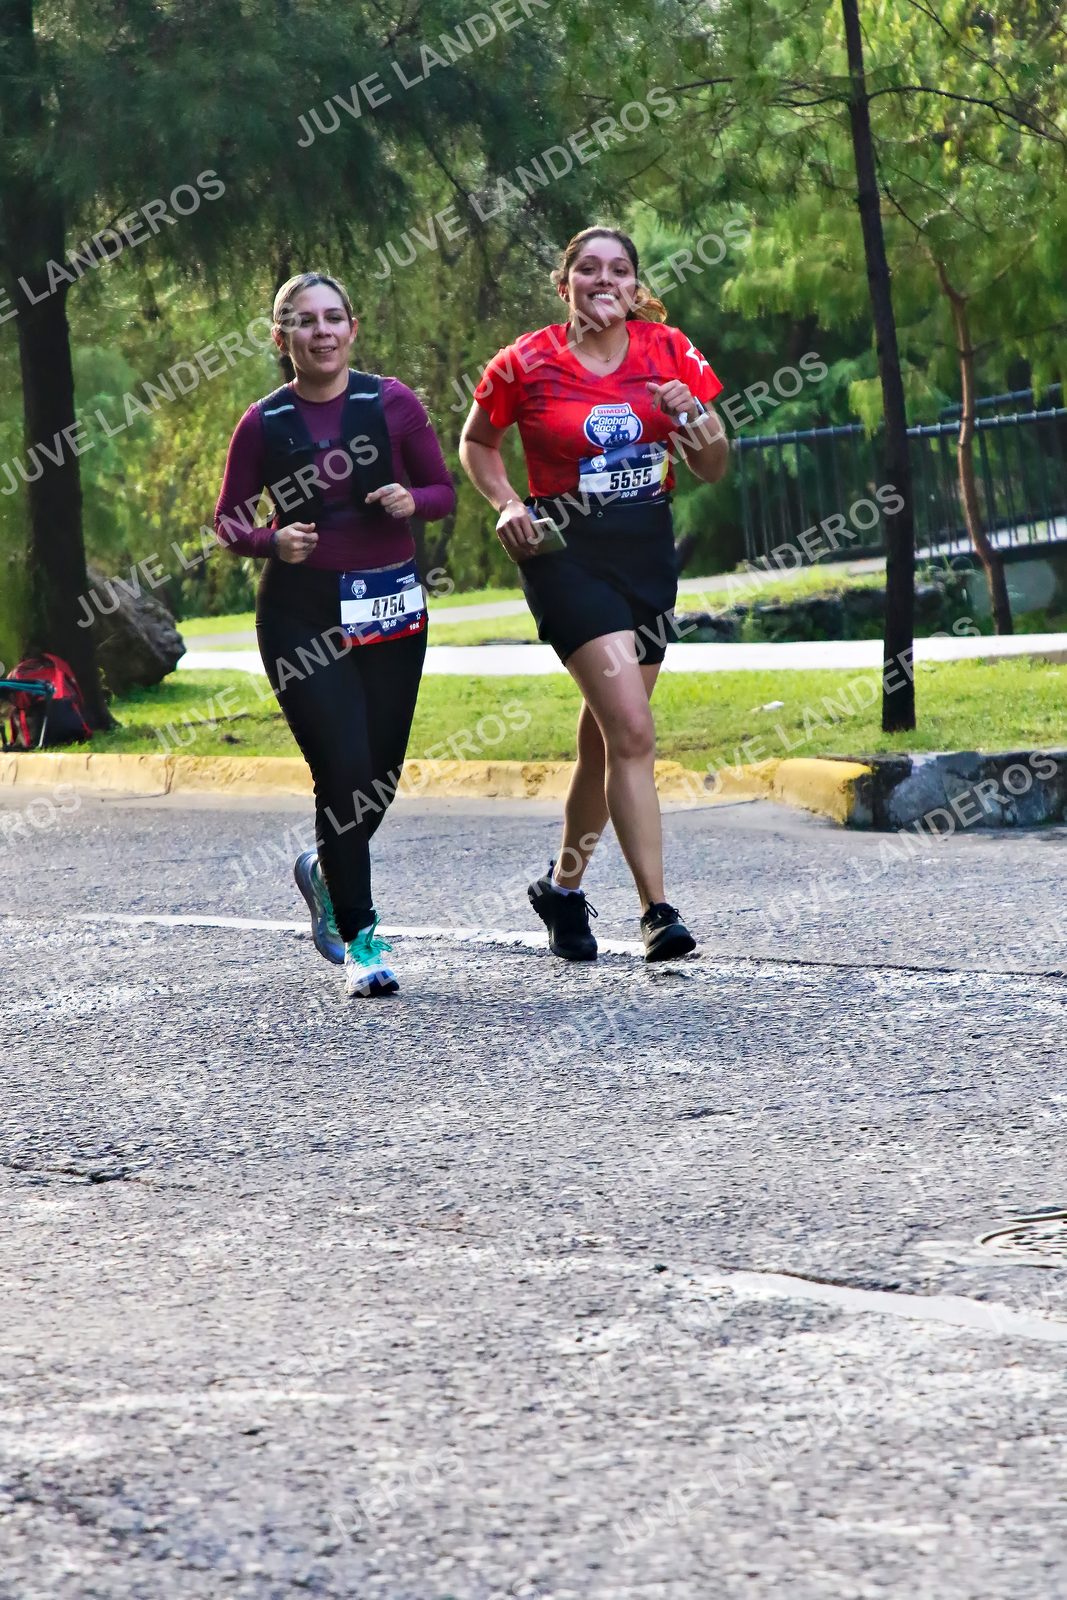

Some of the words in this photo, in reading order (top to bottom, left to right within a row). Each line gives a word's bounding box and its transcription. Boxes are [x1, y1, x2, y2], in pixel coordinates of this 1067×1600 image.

[593, 424, 617, 432] Race
[598, 416, 628, 426] Global
[609, 468, 653, 490] 5555
[371, 594, 406, 619] 4754
